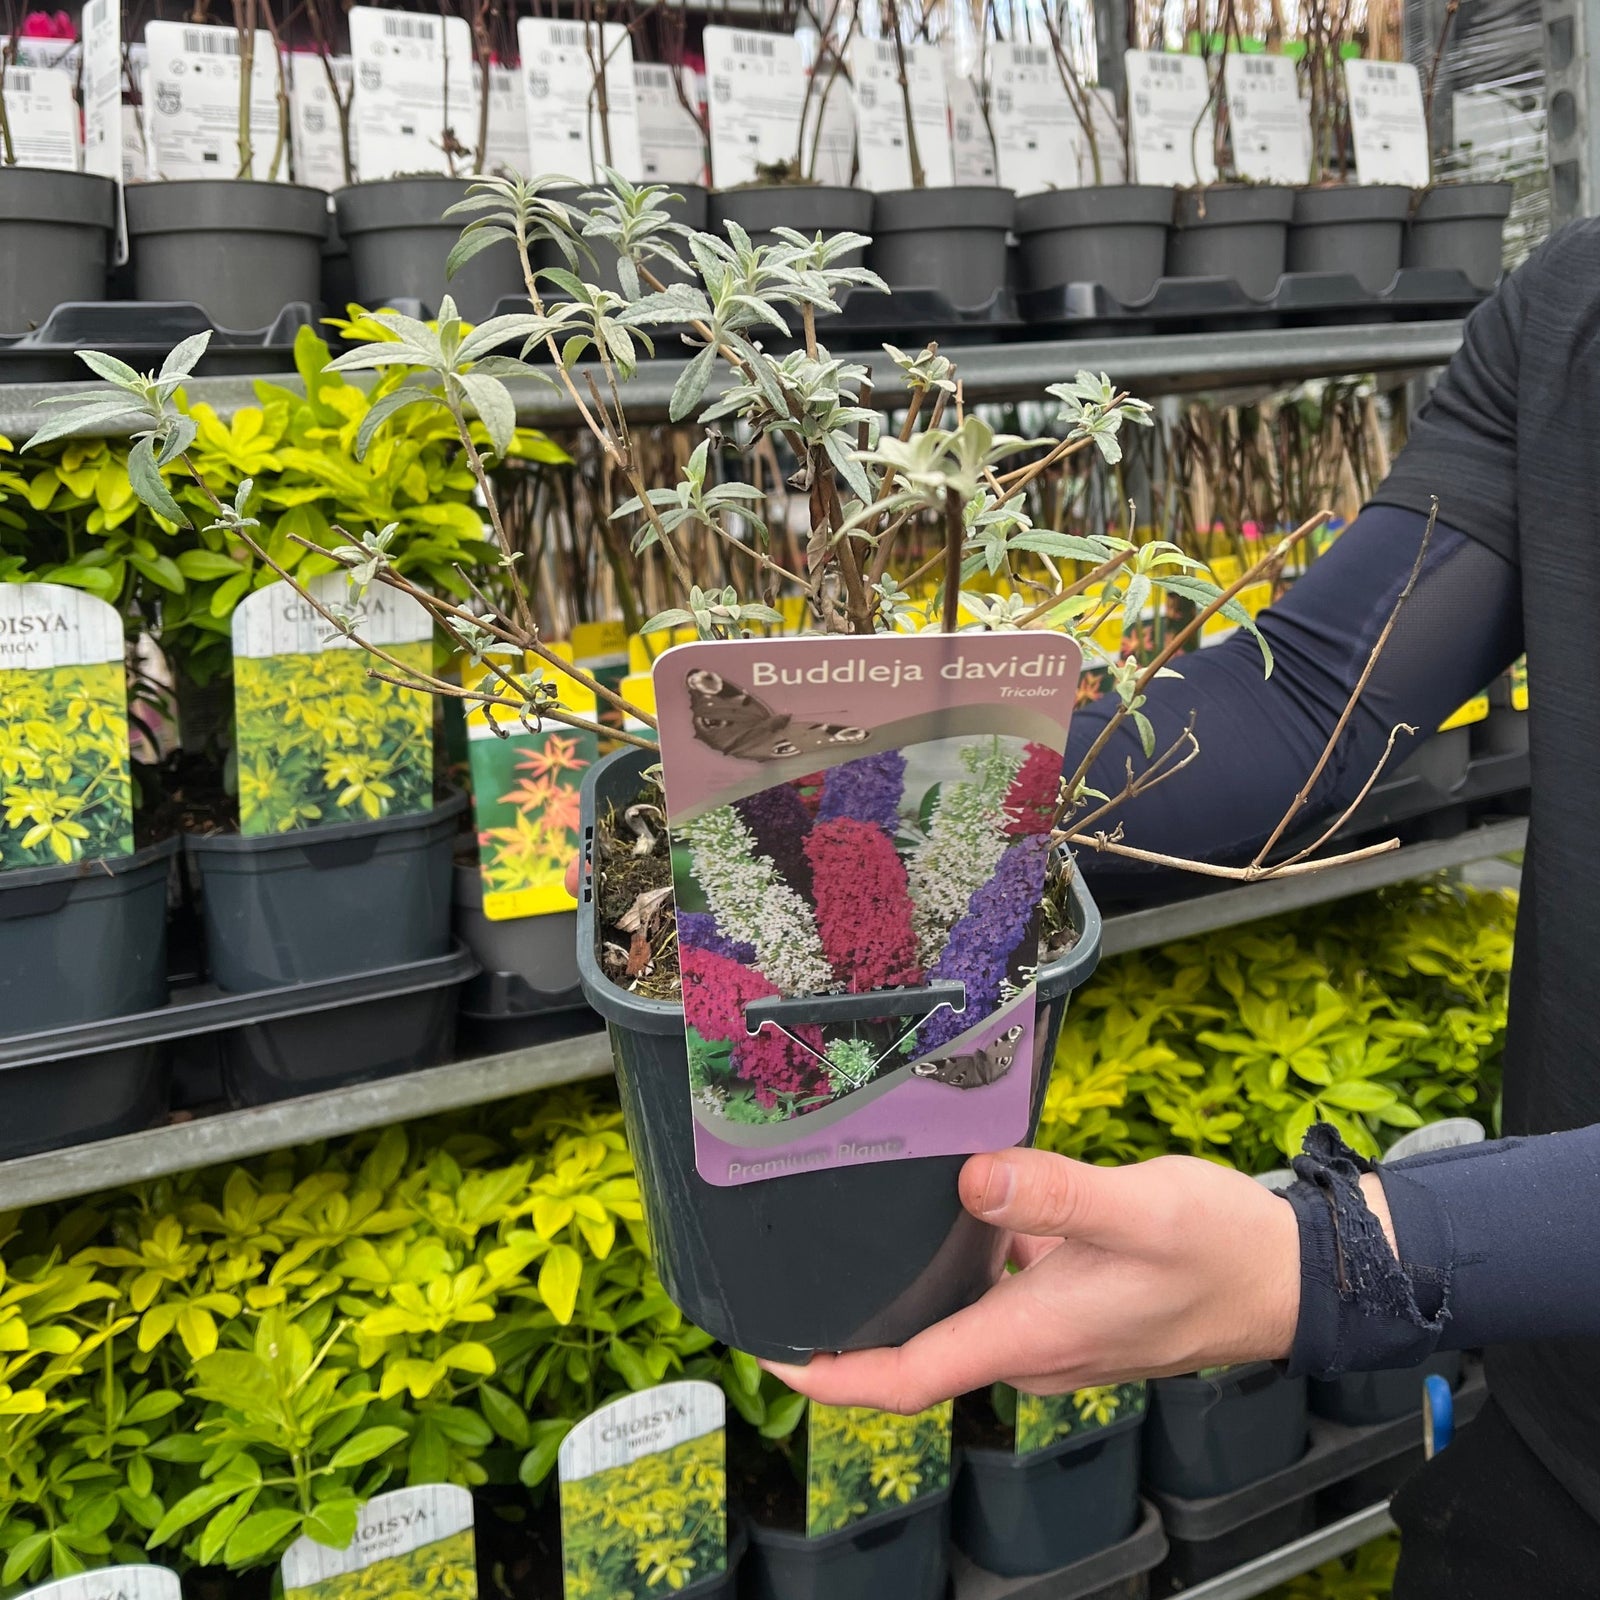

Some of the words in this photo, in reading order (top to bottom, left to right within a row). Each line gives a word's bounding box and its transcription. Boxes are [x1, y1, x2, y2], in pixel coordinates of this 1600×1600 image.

[283, 600, 386, 623] CHSYA
[753, 659, 923, 687] Buddleja
[940, 654, 1066, 679] davidii
[1000, 686, 1059, 699] Tricolor
